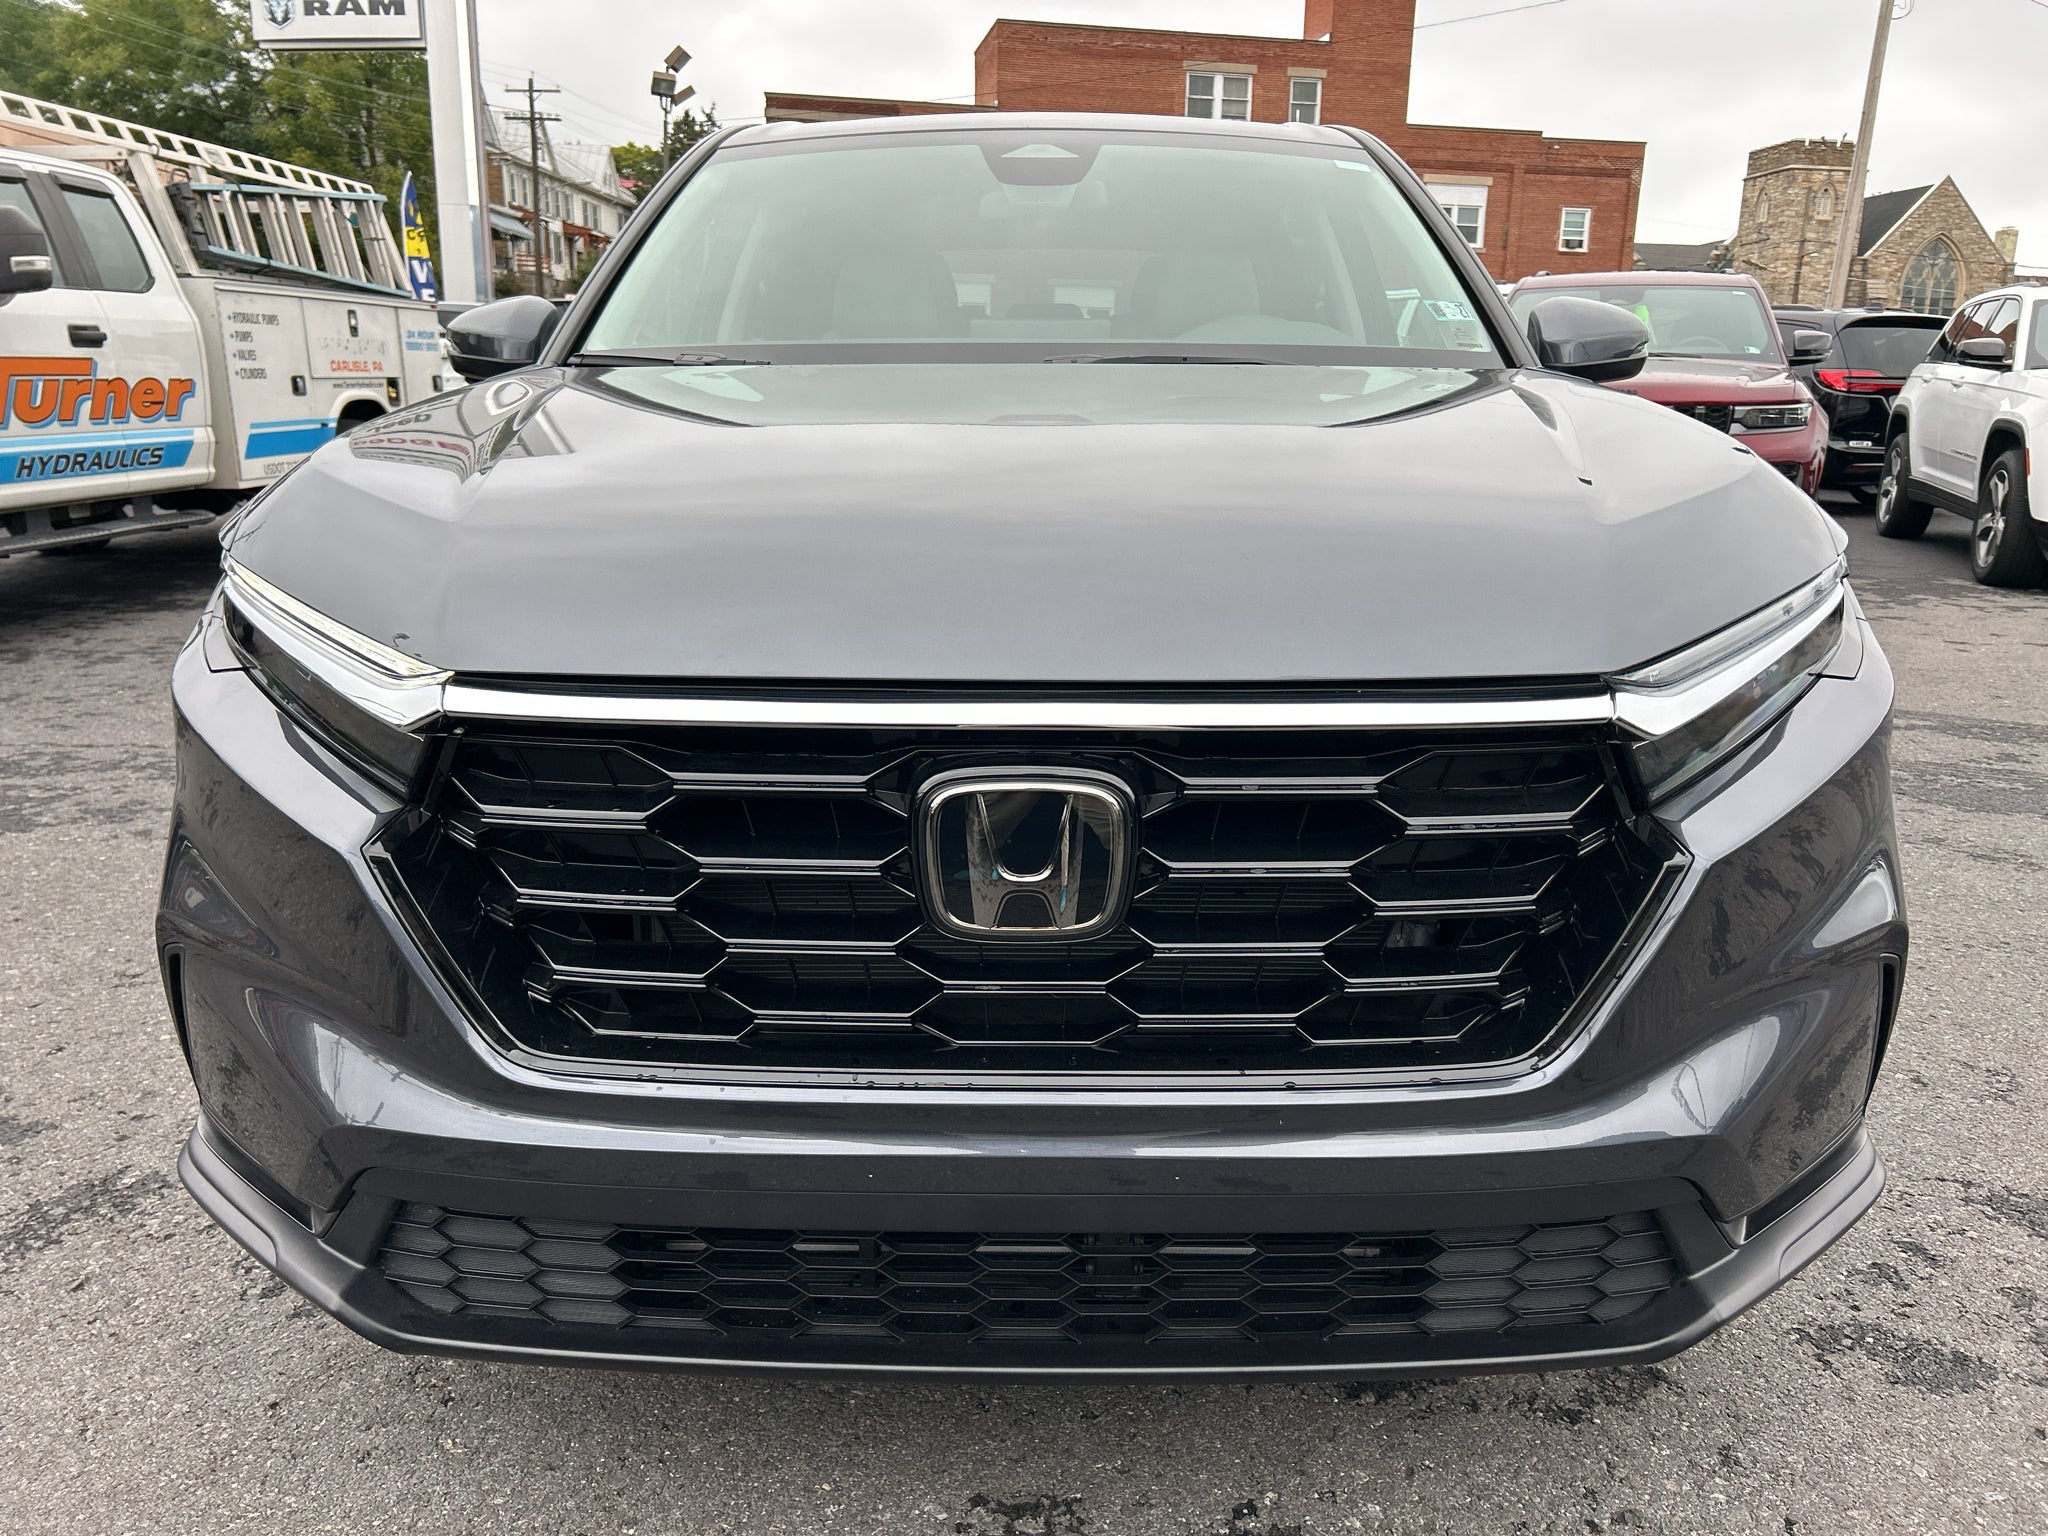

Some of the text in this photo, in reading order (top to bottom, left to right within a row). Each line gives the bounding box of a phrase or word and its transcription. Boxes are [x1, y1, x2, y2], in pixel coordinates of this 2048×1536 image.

[303, 0, 406, 16] RAM
[372, 360, 384, 372] PA
[0, 357, 196, 430] Turner
[16, 447, 164, 479] HYDRAULICS
